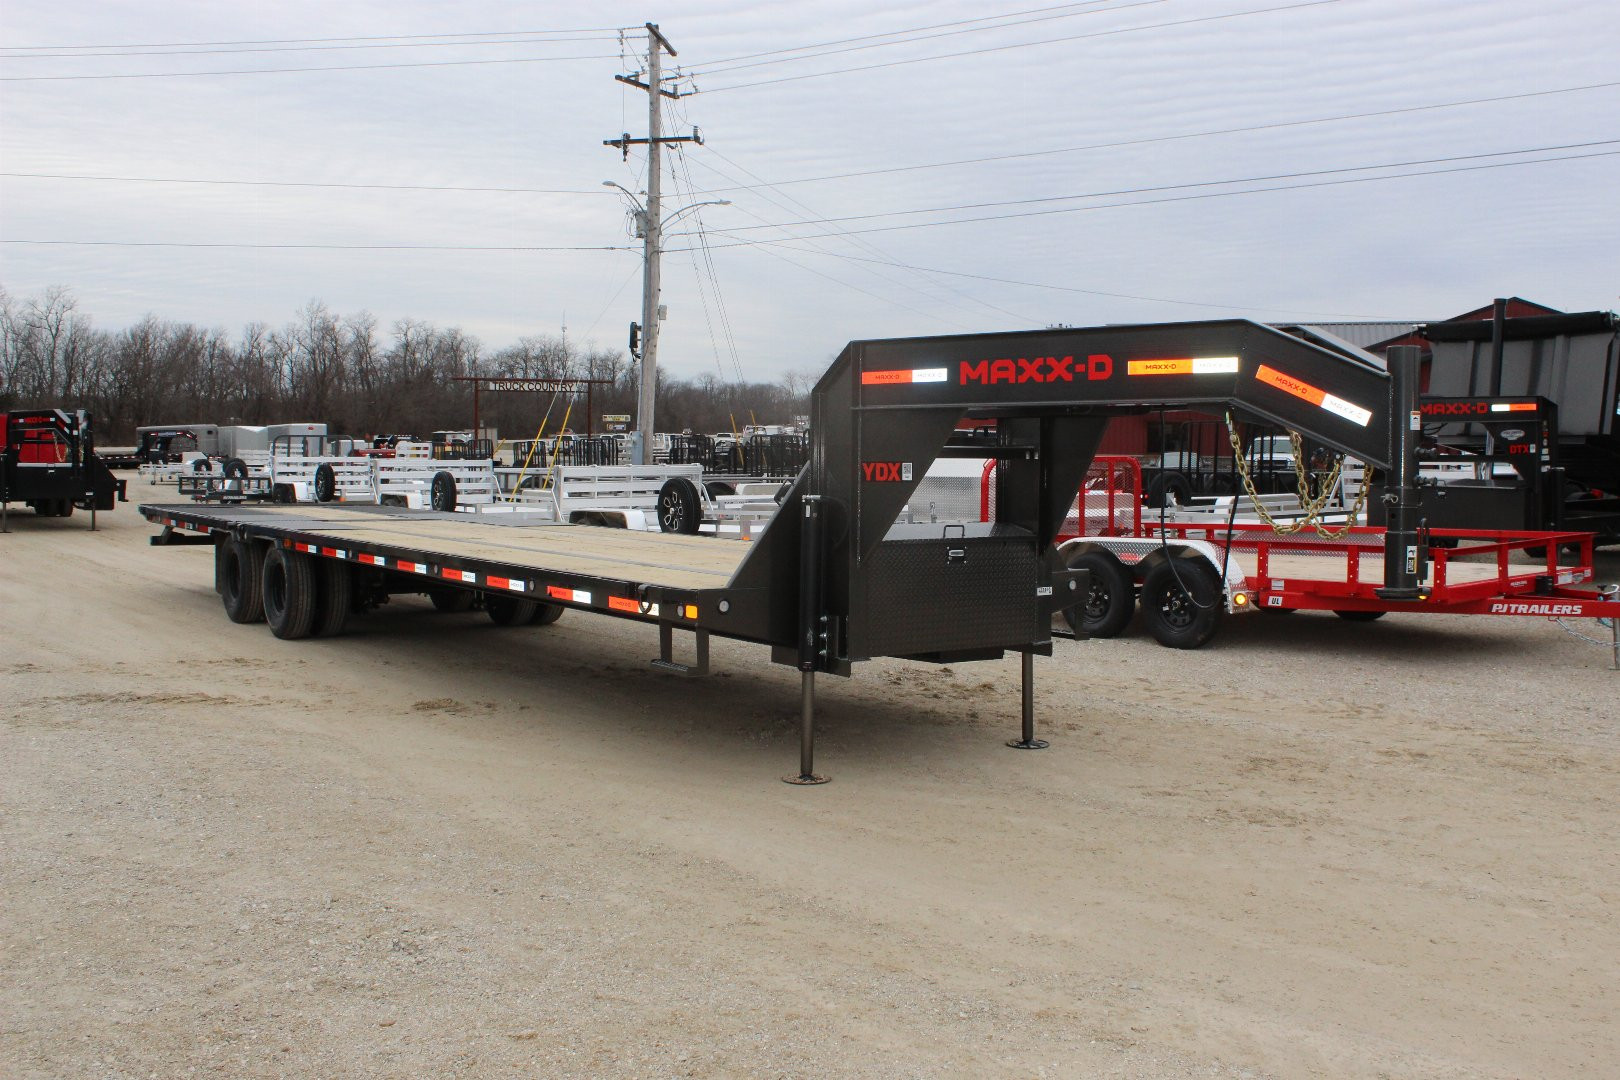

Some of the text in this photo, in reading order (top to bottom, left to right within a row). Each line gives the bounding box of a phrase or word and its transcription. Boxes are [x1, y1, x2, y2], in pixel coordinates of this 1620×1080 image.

[959, 354, 1113, 385] MAXX-D
[1145, 363, 1177, 371] MAXX-D
[493, 382, 575, 392] TRUCK COUNTRY
[1275, 375, 1308, 395] MAXX-D
[1420, 402, 1489, 415] MAXX-D
[863, 462, 901, 481] YDX
[1509, 604, 1583, 615] TRAILERS
